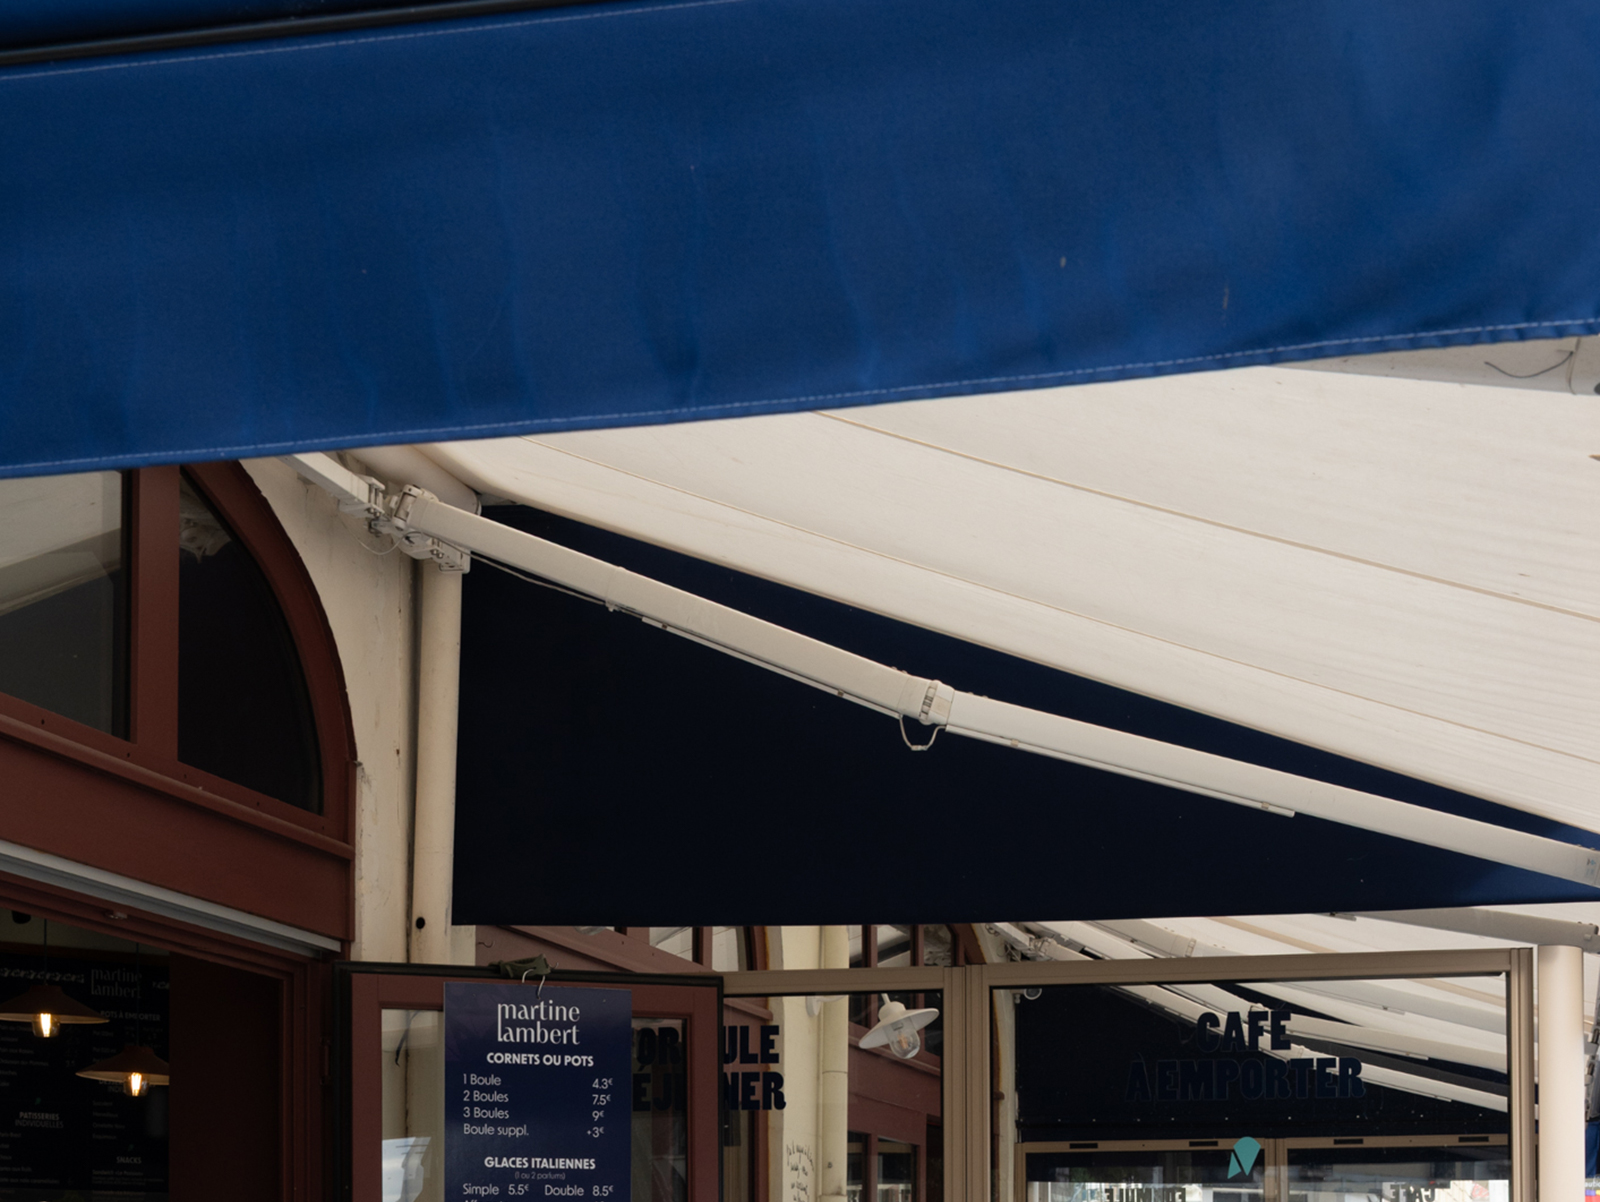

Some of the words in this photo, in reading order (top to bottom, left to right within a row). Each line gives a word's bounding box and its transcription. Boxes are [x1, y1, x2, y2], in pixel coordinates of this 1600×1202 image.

[498, 1000, 580, 1021] martine
[498, 1021, 580, 1044] lambert
[487, 1052, 540, 1065] CORNETS
[543, 1055, 561, 1065] OU
[564, 1055, 594, 1066] POTS
[463, 1074, 467, 1084] 1
[470, 1074, 501, 1086] Boule
[592, 1078, 613, 1089] 4.3€
[463, 1090, 470, 1101] 2
[473, 1091, 509, 1103] Boules
[463, 1107, 470, 1117] 3
[473, 1108, 509, 1119] Boules
[592, 1111, 604, 1121] 9€
[464, 1124, 495, 1135] Boule
[497, 1125, 529, 1137] suppl.
[484, 1156, 529, 1168] GLACES
[531, 1158, 596, 1169] ITALIENNES
[463, 1184, 499, 1196] Simple
[508, 1184, 529, 1195] 5.5€
[545, 1185, 584, 1196] Double
[592, 1185, 613, 1196] 8.5€
